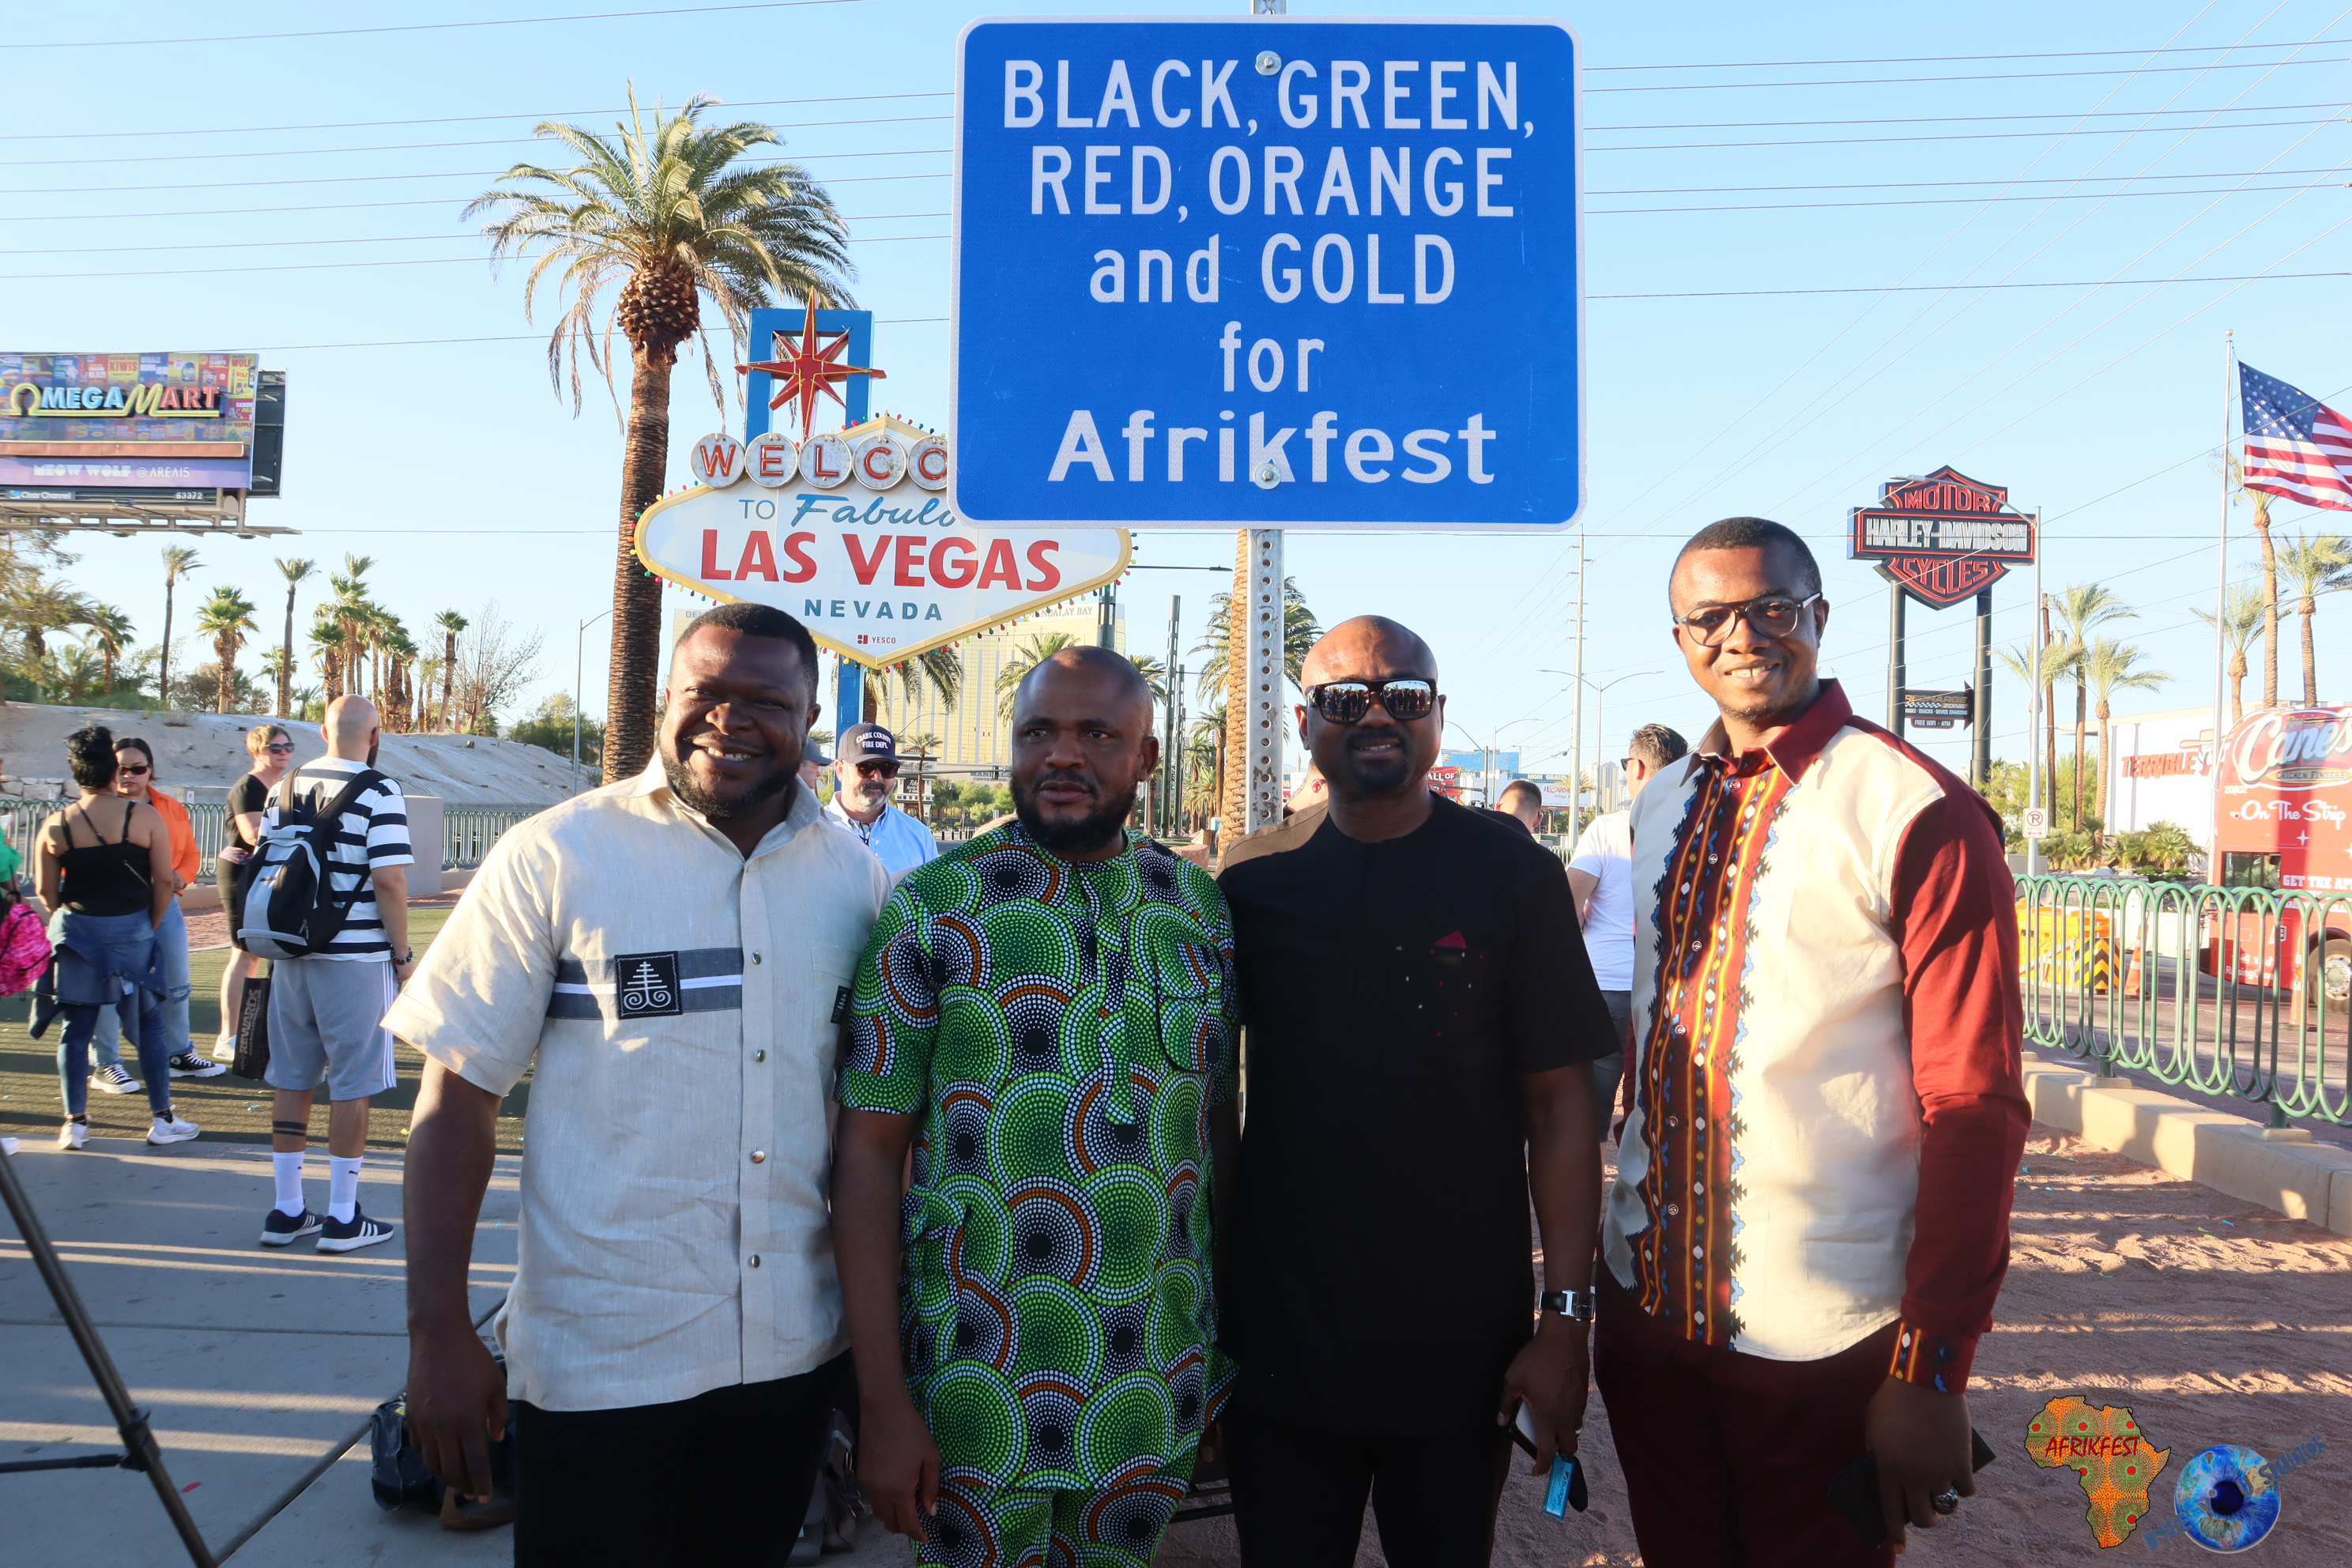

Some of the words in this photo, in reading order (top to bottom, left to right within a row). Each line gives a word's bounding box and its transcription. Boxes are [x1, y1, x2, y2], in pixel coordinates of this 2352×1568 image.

[1003, 59, 1258, 136] BLACK,
[1277, 60, 1535, 138] GREEN,
[1031, 145, 1189, 223] RED,
[1208, 145, 1514, 217] ORANGE
[1089, 233, 1219, 303] and
[1261, 233, 1455, 304] GOLD
[1219, 321, 1325, 393] for
[1047, 409, 1497, 484] Afrikfest
[33, 464, 83, 477] MEOW
[85, 465, 131, 477] WOLF
[738, 499, 776, 520] TO
[1904, 483, 1991, 512] MOTOR
[1866, 518, 2028, 552] HARLEY-DAVIDSON
[700, 529, 816, 583] LAS
[842, 533, 1061, 592] VEGAS
[1902, 557, 1988, 594] CYCLES
[805, 599, 943, 621] NEVADA
[1027, 607, 1075, 618] MNDALAY
[1077, 606, 1093, 616] BAY
[1905, 695, 1968, 703] RECHARGE
[856, 732, 873, 744] CLARK
[873, 731, 891, 744] COUNTY
[2241, 800, 2270, 820] On
[2267, 801, 2301, 820] The
[2302, 800, 2346, 830] Strip
[2282, 875, 2306, 887] GET
[2308, 876, 2332, 889] THE
[239, 989, 260, 1055] REWARDS
[1557, 1481, 1568, 1506] Budget
